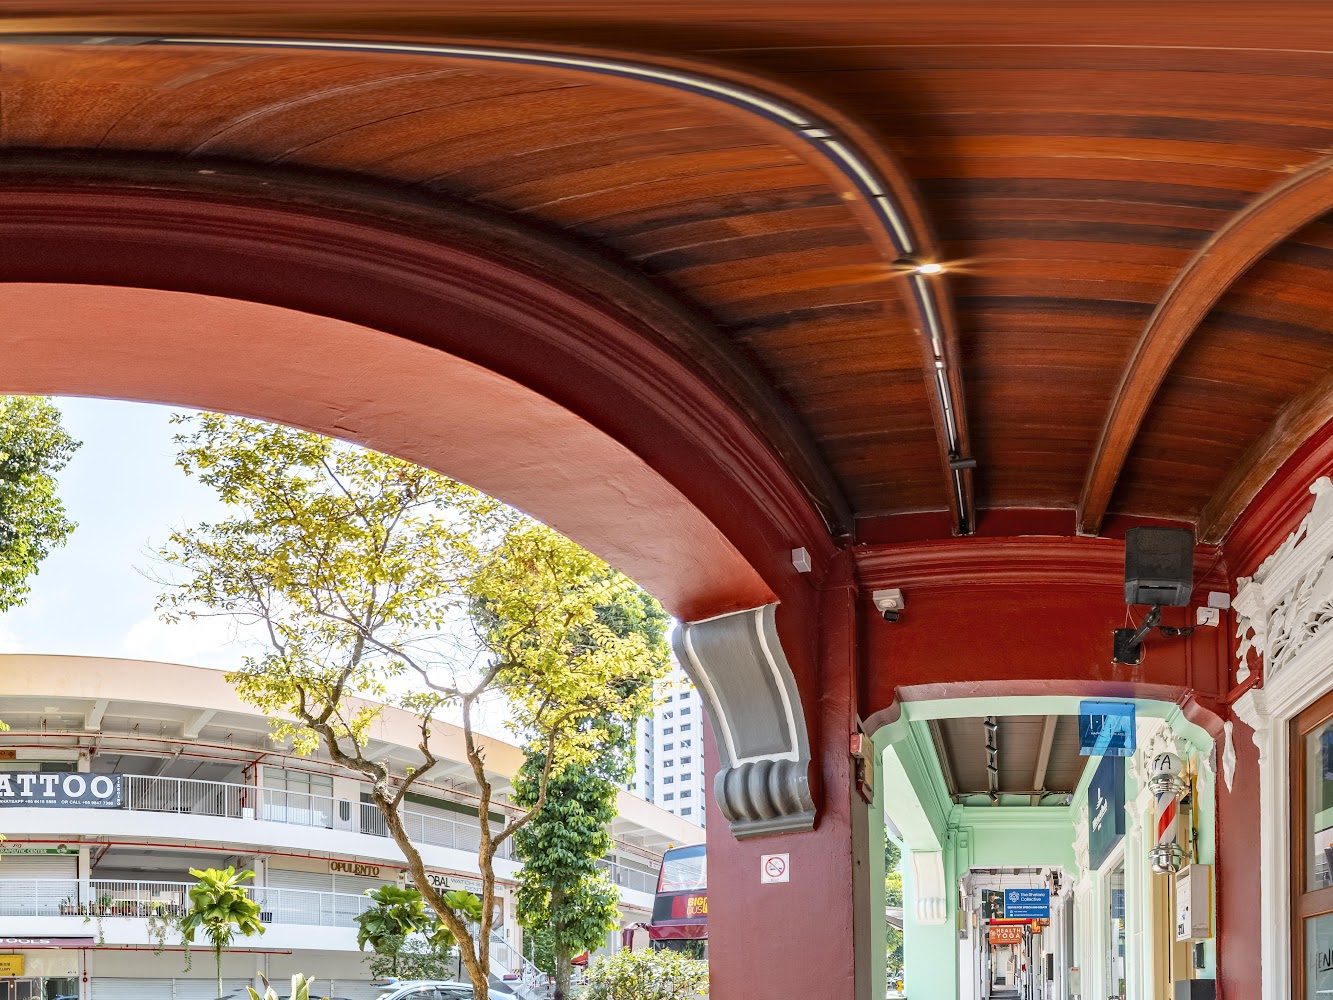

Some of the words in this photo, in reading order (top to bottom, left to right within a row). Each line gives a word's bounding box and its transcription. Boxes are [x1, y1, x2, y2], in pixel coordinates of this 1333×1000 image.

[330, 861, 380, 876] OPULENTO
[688, 897, 703, 907] BIG
[686, 906, 703, 915] BUS
